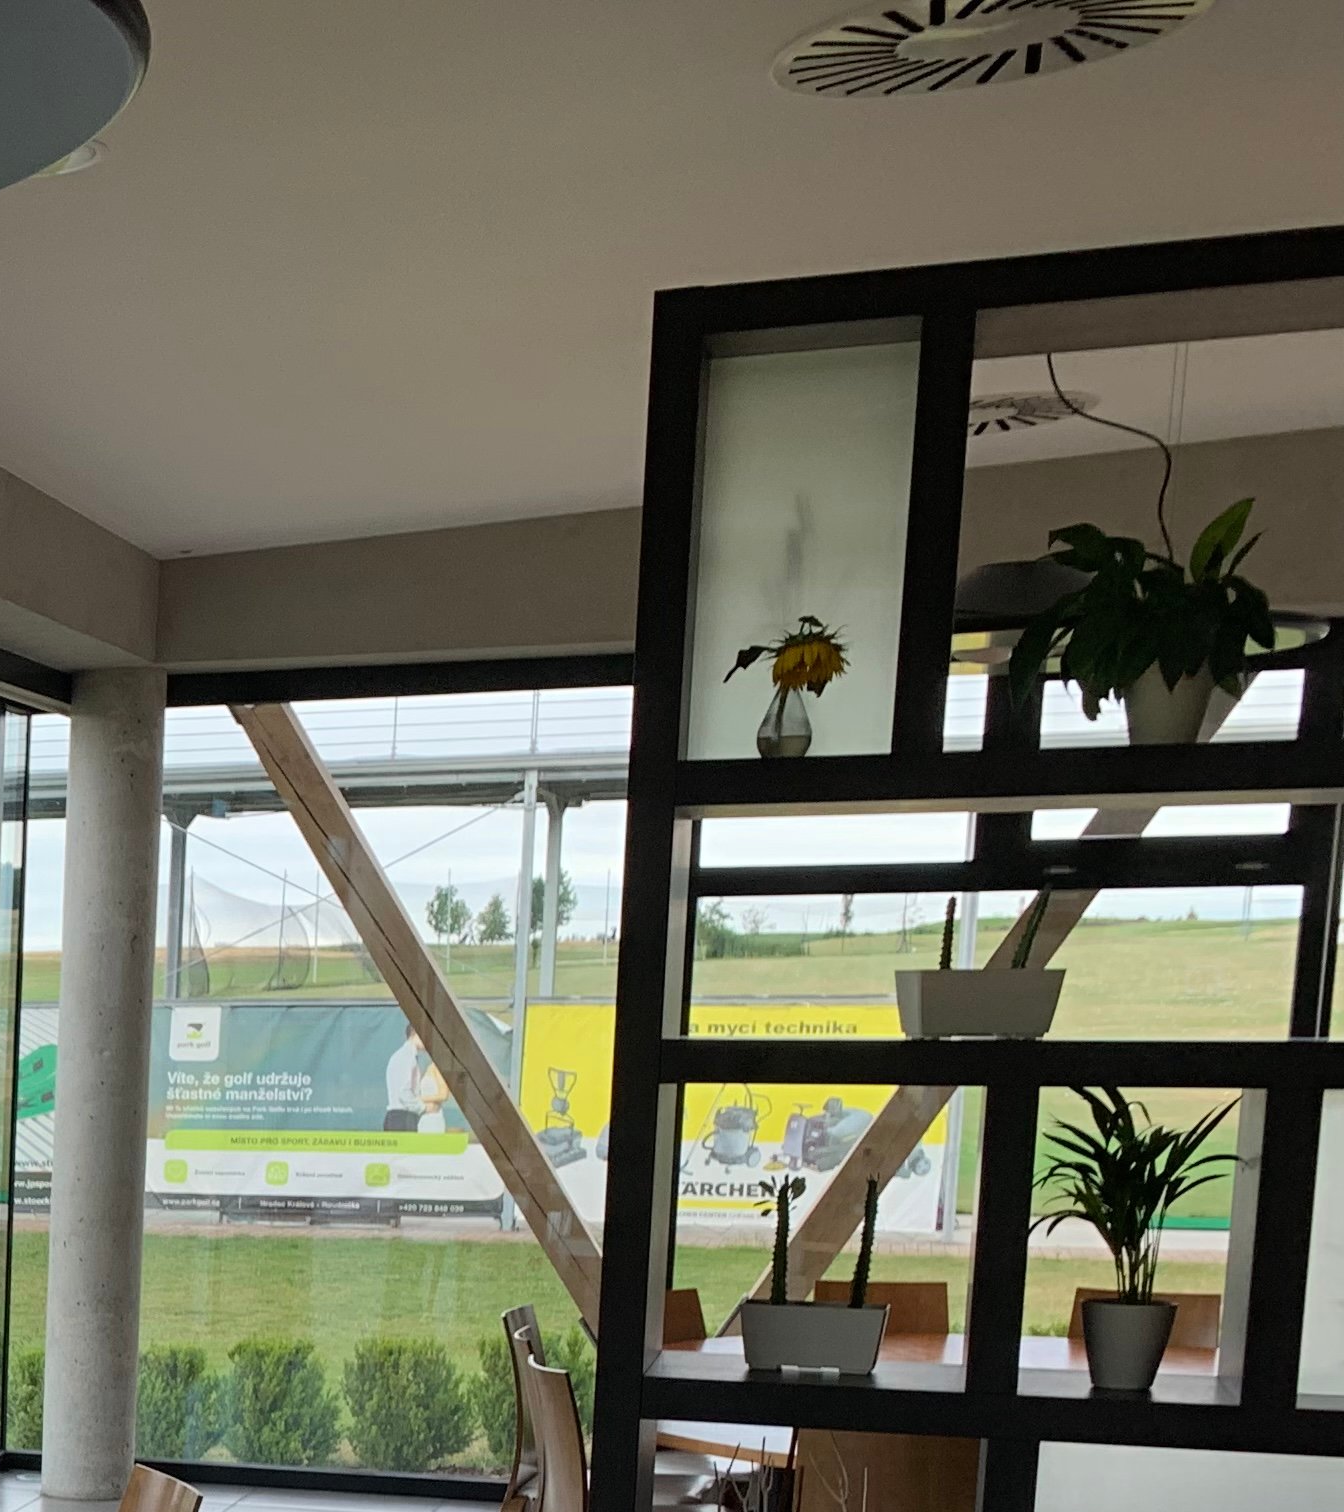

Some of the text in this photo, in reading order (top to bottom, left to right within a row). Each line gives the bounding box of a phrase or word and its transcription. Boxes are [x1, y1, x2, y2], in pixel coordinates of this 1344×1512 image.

[707, 1020, 756, 1036] mycí
[765, 1020, 858, 1034] technika
[167, 1071, 312, 1088] Víte, že golf udržuje
[166, 1087, 313, 1101] šťastné manželství?
[230, 1135, 258, 1145] MÍSTO
[260, 1137, 279, 1145] PRO
[353, 1138, 399, 1147] BUSINESS
[681, 1181, 775, 1197] ÄRCHE
